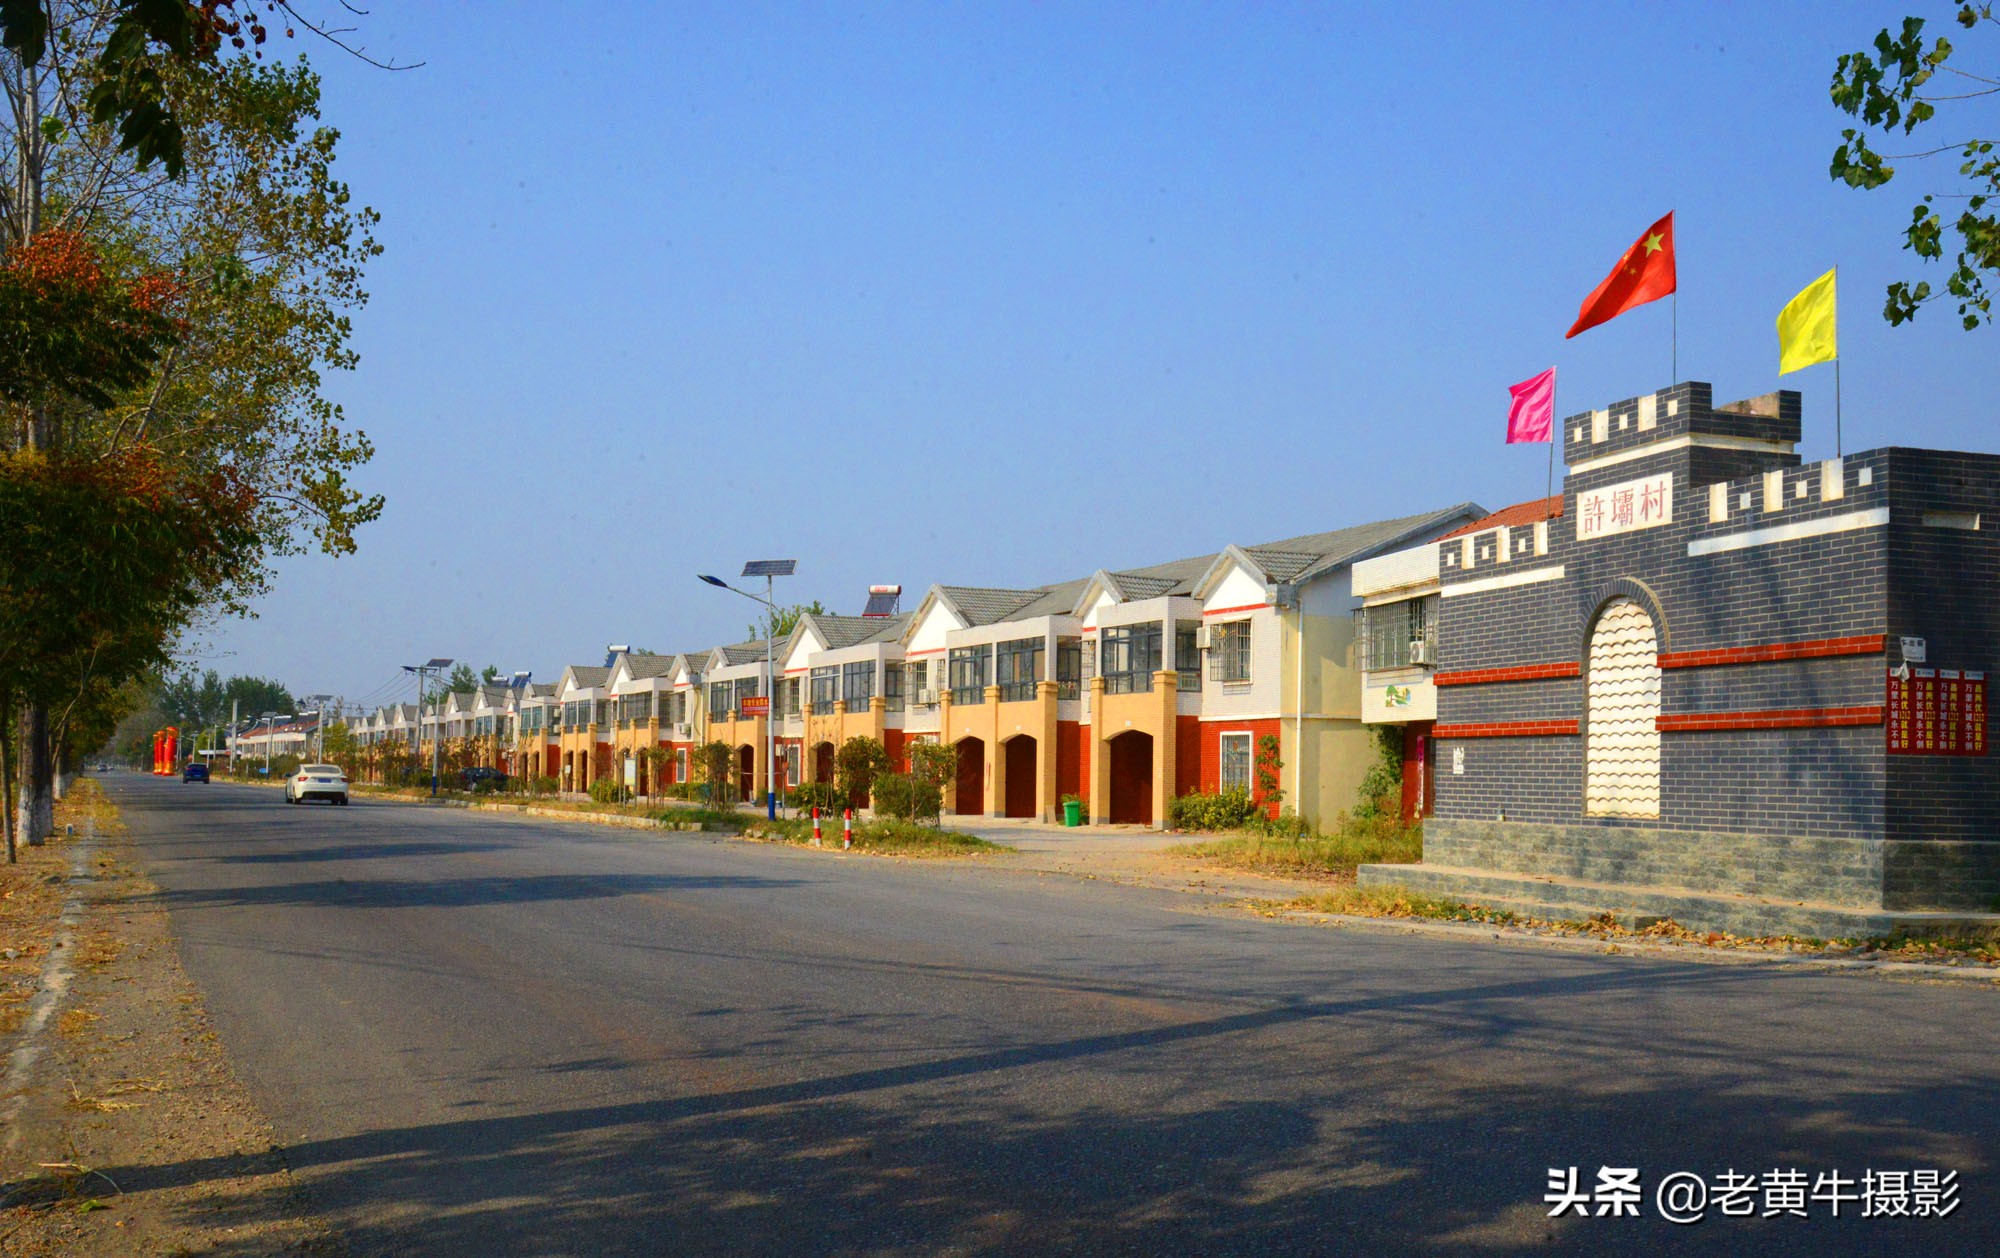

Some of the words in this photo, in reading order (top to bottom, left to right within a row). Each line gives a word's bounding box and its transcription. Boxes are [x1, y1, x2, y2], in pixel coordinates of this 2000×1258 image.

[1583, 480, 1667, 534] 許壩村
[1891, 681, 1899, 749] 万里长城永不倒
[1916, 681, 1924, 749] 万里长城永不倒
[1939, 683, 1948, 750] 万里长城永不倒
[1965, 684, 1973, 751] 万里长城永不倒
